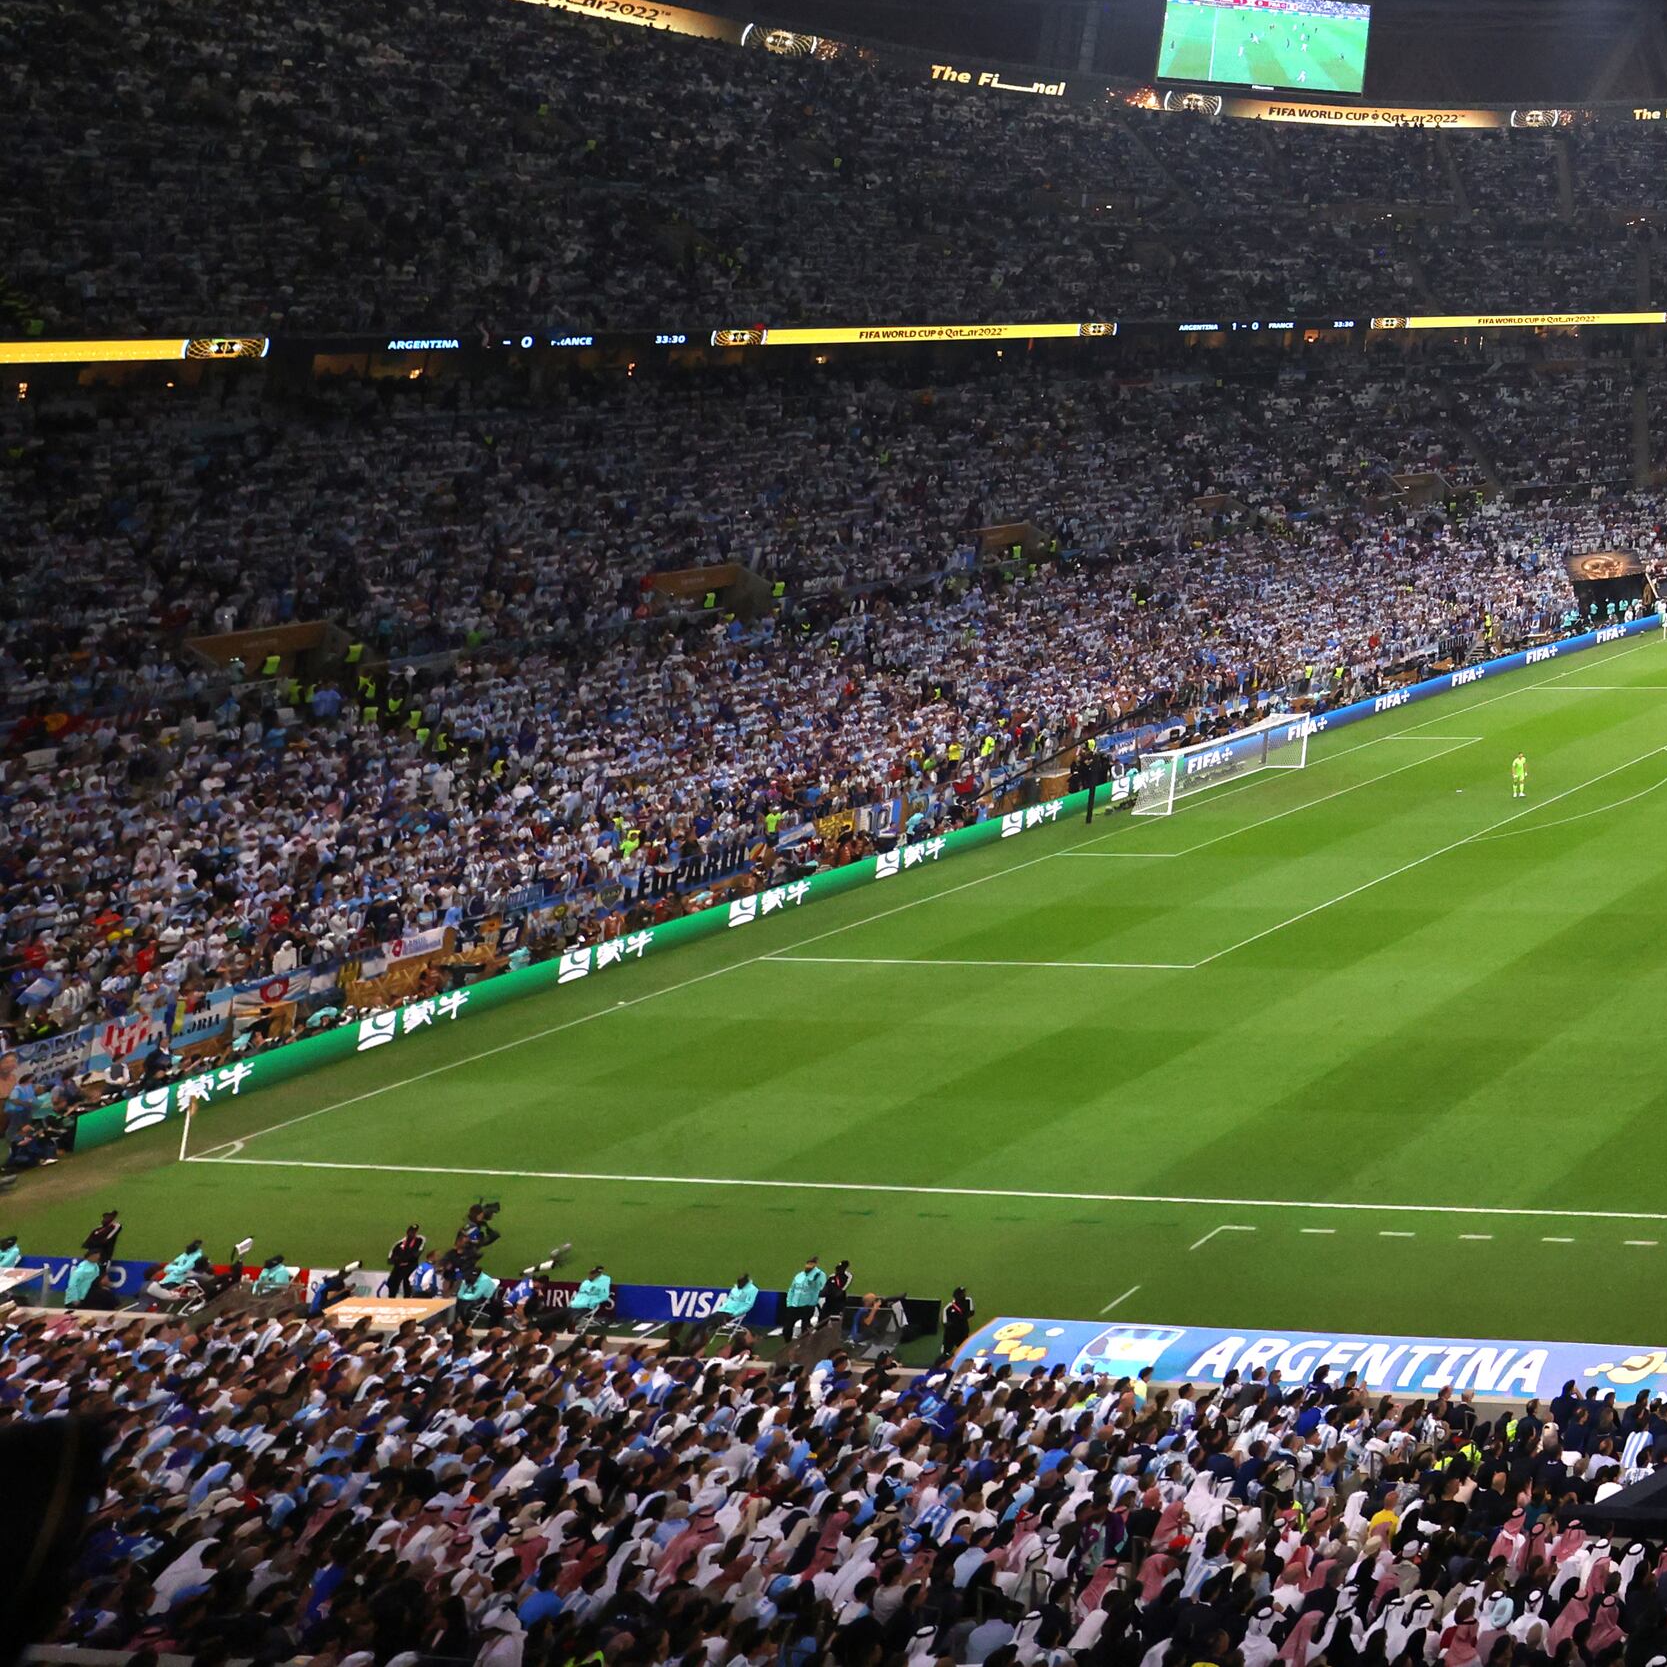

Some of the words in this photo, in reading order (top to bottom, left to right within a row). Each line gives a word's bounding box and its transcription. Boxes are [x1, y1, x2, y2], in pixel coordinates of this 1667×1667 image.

[931, 64, 971, 83] The
[1269, 106, 1297, 118] FIFA
[1299, 108, 1335, 120] WORLD
[1338, 111, 1369, 121] CUP
[1634, 108, 1660, 121] The
[1495, 317, 1523, 325] WORLD
[859, 331, 881, 339] FIFA
[882, 330, 916, 339] WORLD
[918, 329, 936, 338] CUP
[388, 338, 459, 350] ARGENTINA
[551, 336, 593, 347] ANCE
[655, 335, 685, 344] 33:30
[1186, 1336, 1549, 1392] ARGENTINA
